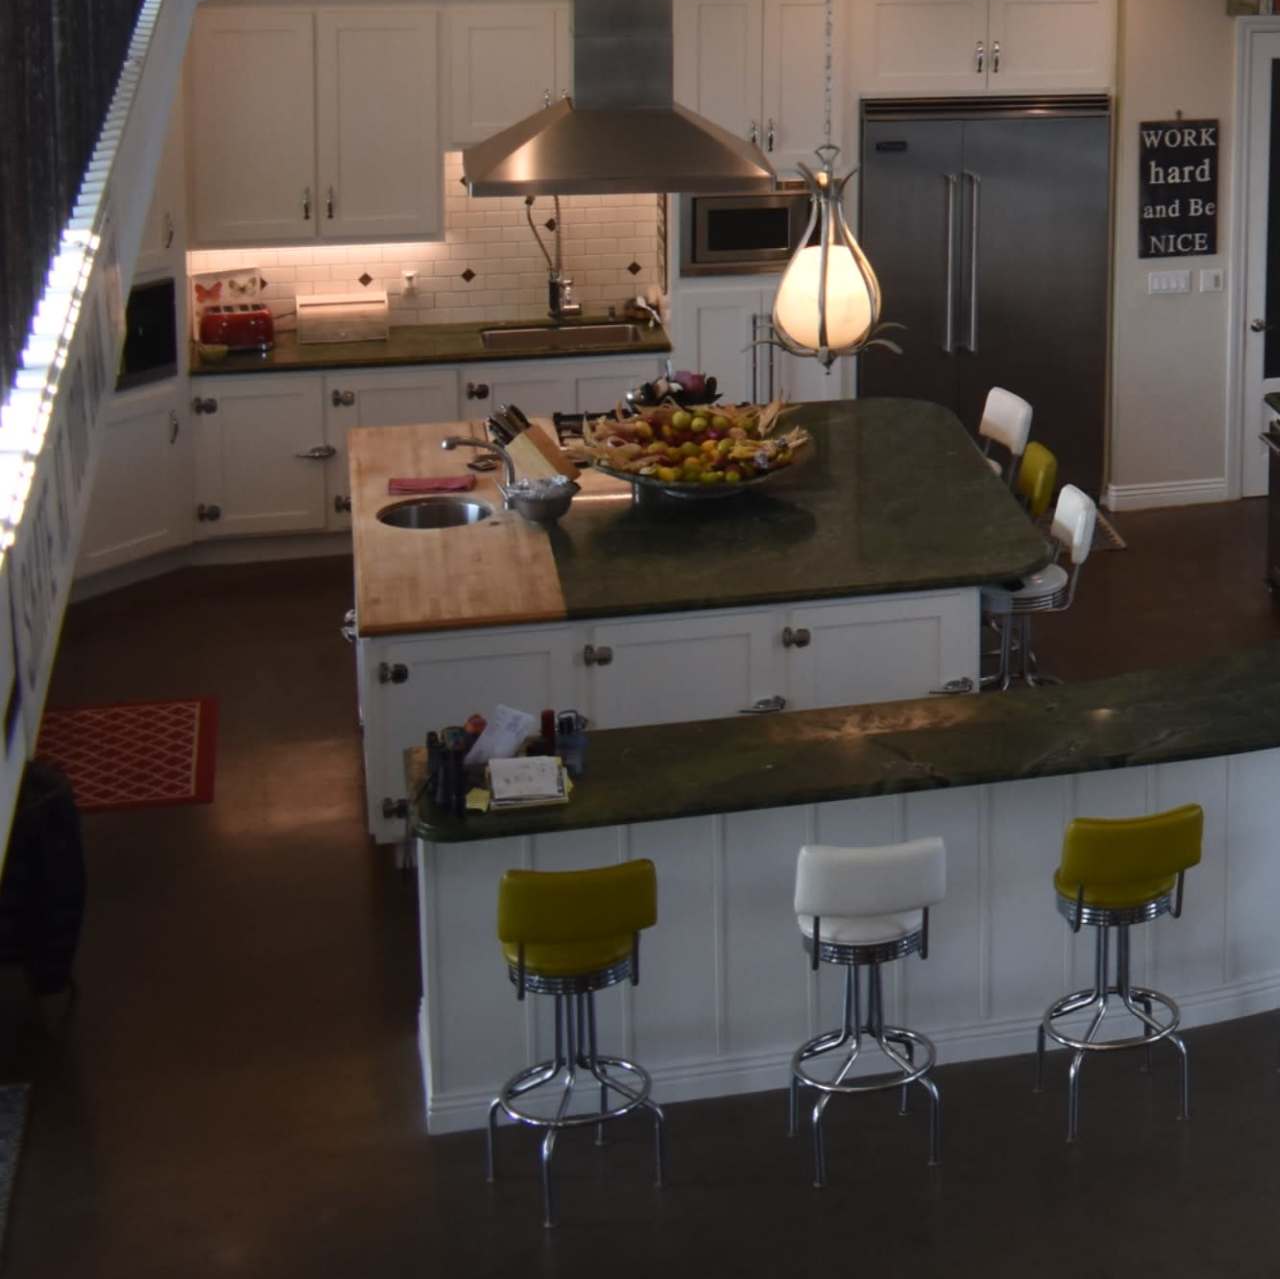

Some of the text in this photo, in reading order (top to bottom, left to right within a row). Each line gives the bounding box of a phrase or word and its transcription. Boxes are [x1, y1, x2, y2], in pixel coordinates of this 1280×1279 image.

[1142, 128, 1216, 148] WORK
[1150, 159, 1211, 184] hard
[1143, 198, 1216, 218] and Be
[1150, 233, 1208, 253] NICE
